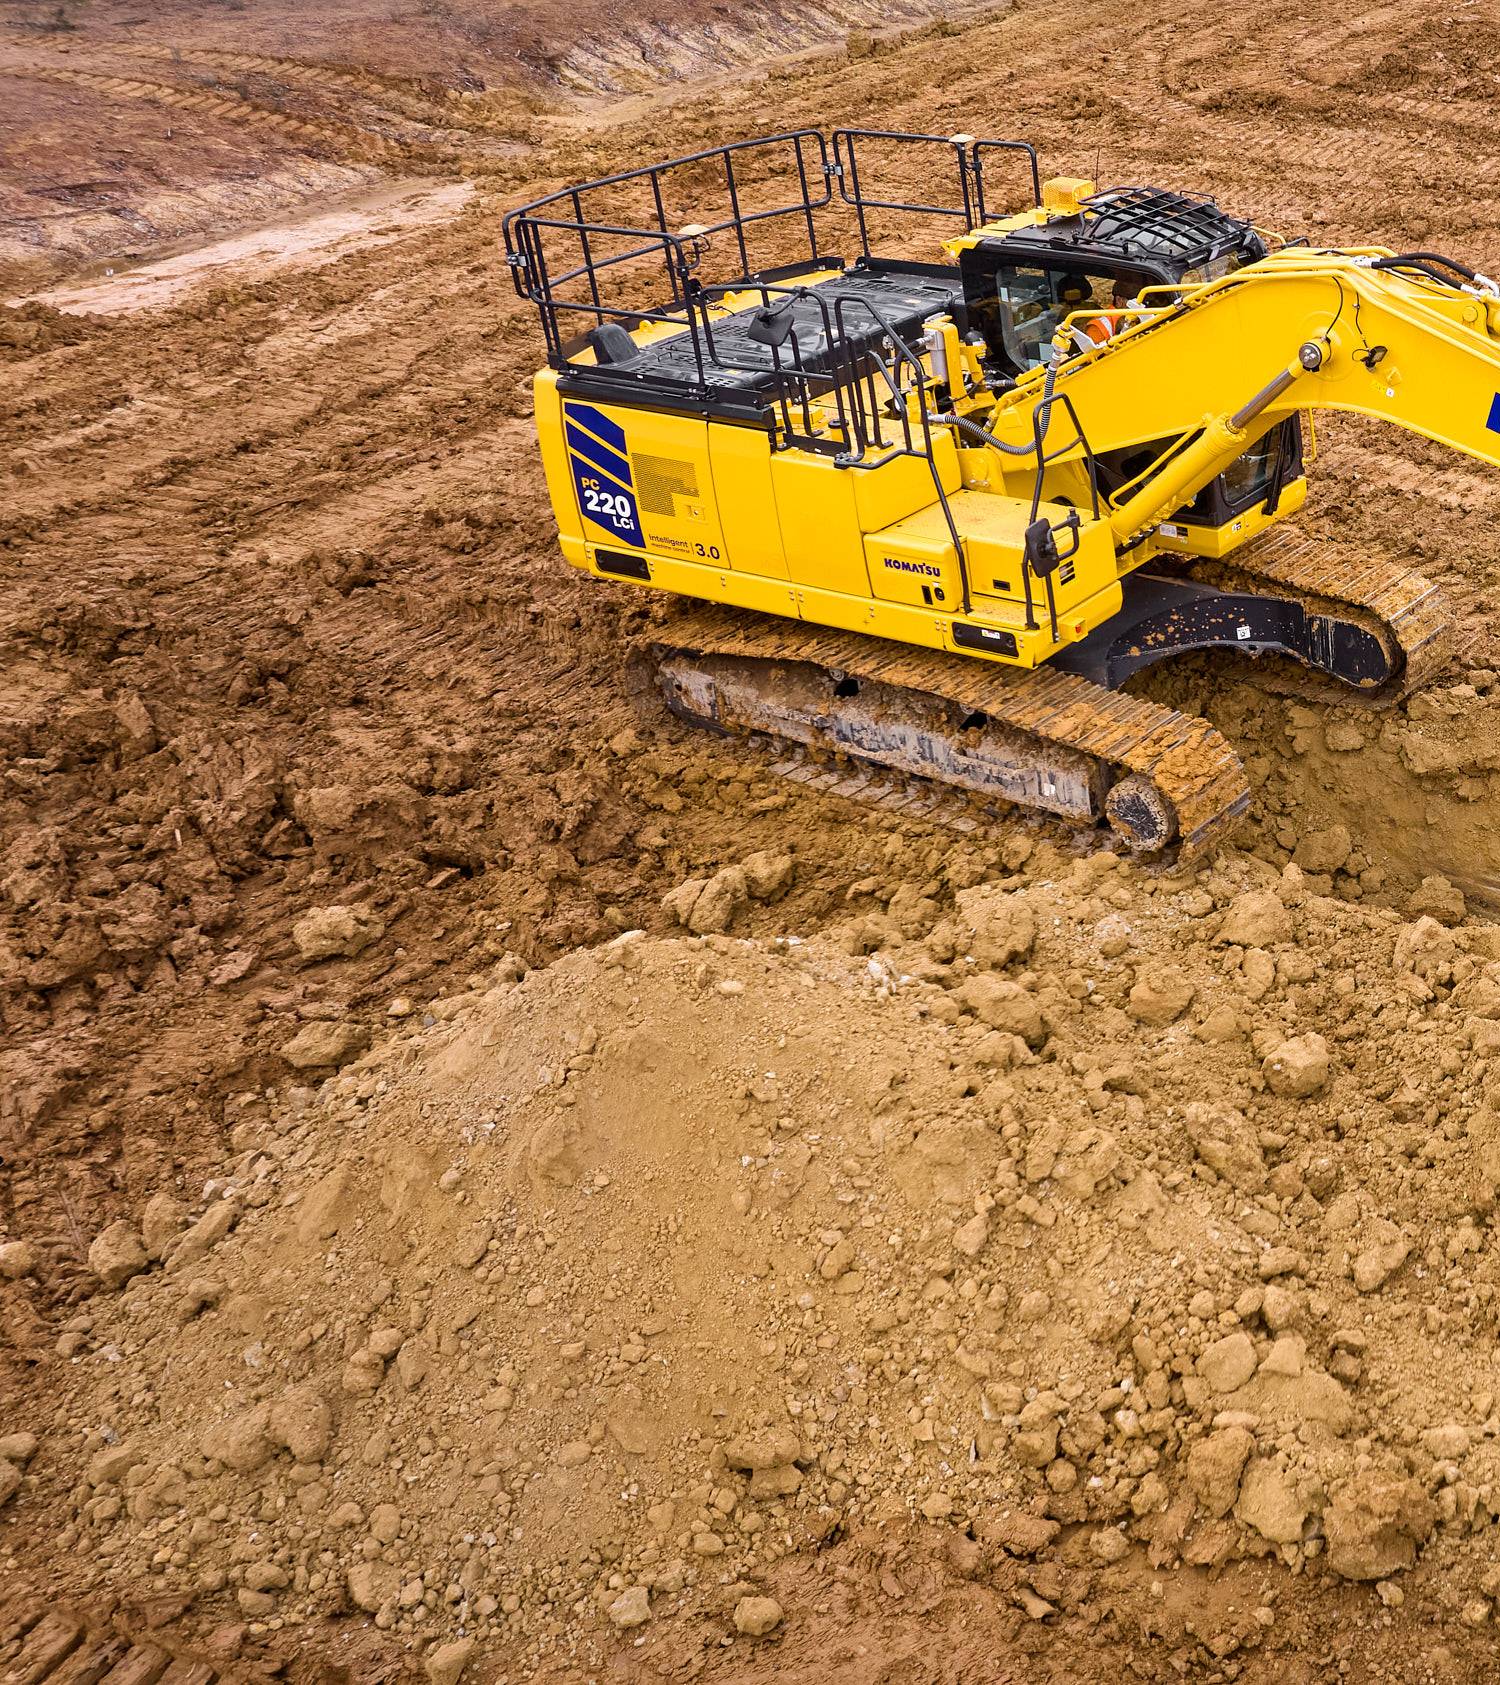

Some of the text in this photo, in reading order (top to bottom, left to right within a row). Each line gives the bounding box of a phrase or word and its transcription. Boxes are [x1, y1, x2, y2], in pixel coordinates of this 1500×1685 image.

[581, 477, 600, 490] PC
[584, 489, 631, 518] 220
[612, 516, 635, 530] LCi
[695, 543, 720, 560] 3.0
[884, 557, 941, 577] KOMATSU
